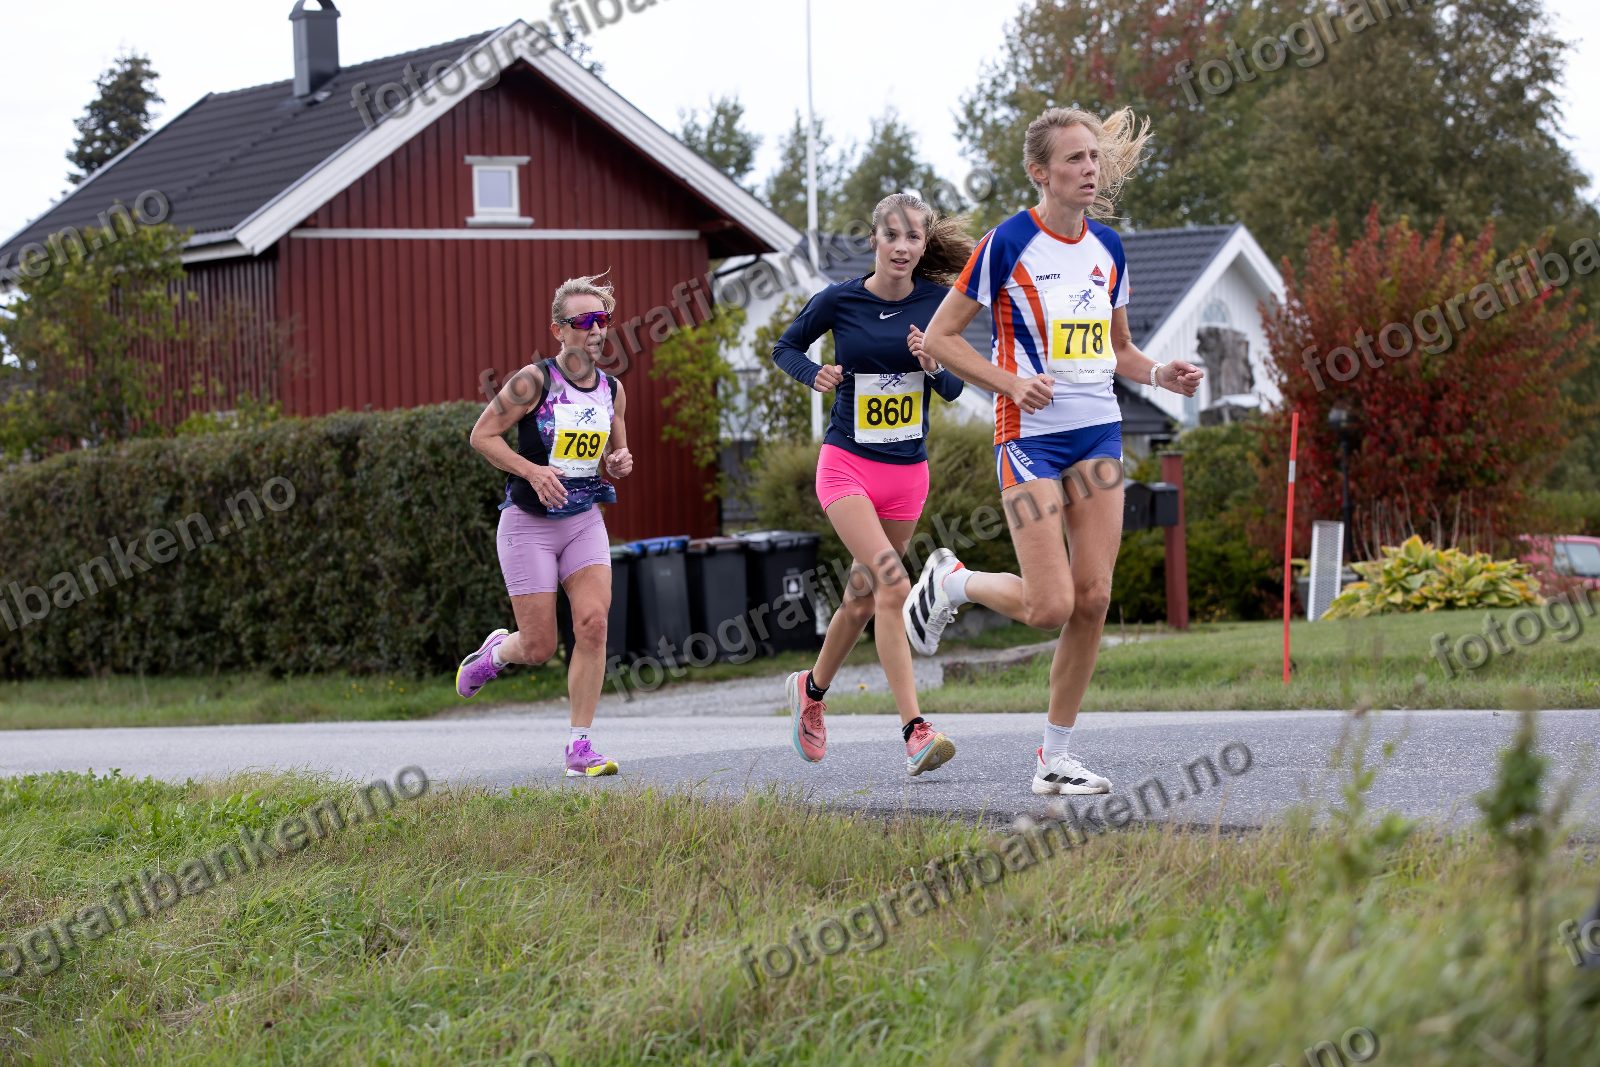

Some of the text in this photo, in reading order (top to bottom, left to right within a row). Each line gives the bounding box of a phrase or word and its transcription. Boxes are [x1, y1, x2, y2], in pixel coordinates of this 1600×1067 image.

[1035, 273, 1061, 281] TRIMTEX
[1060, 322, 1104, 355] 778
[866, 395, 913, 426] 860
[563, 432, 601, 458] 769
